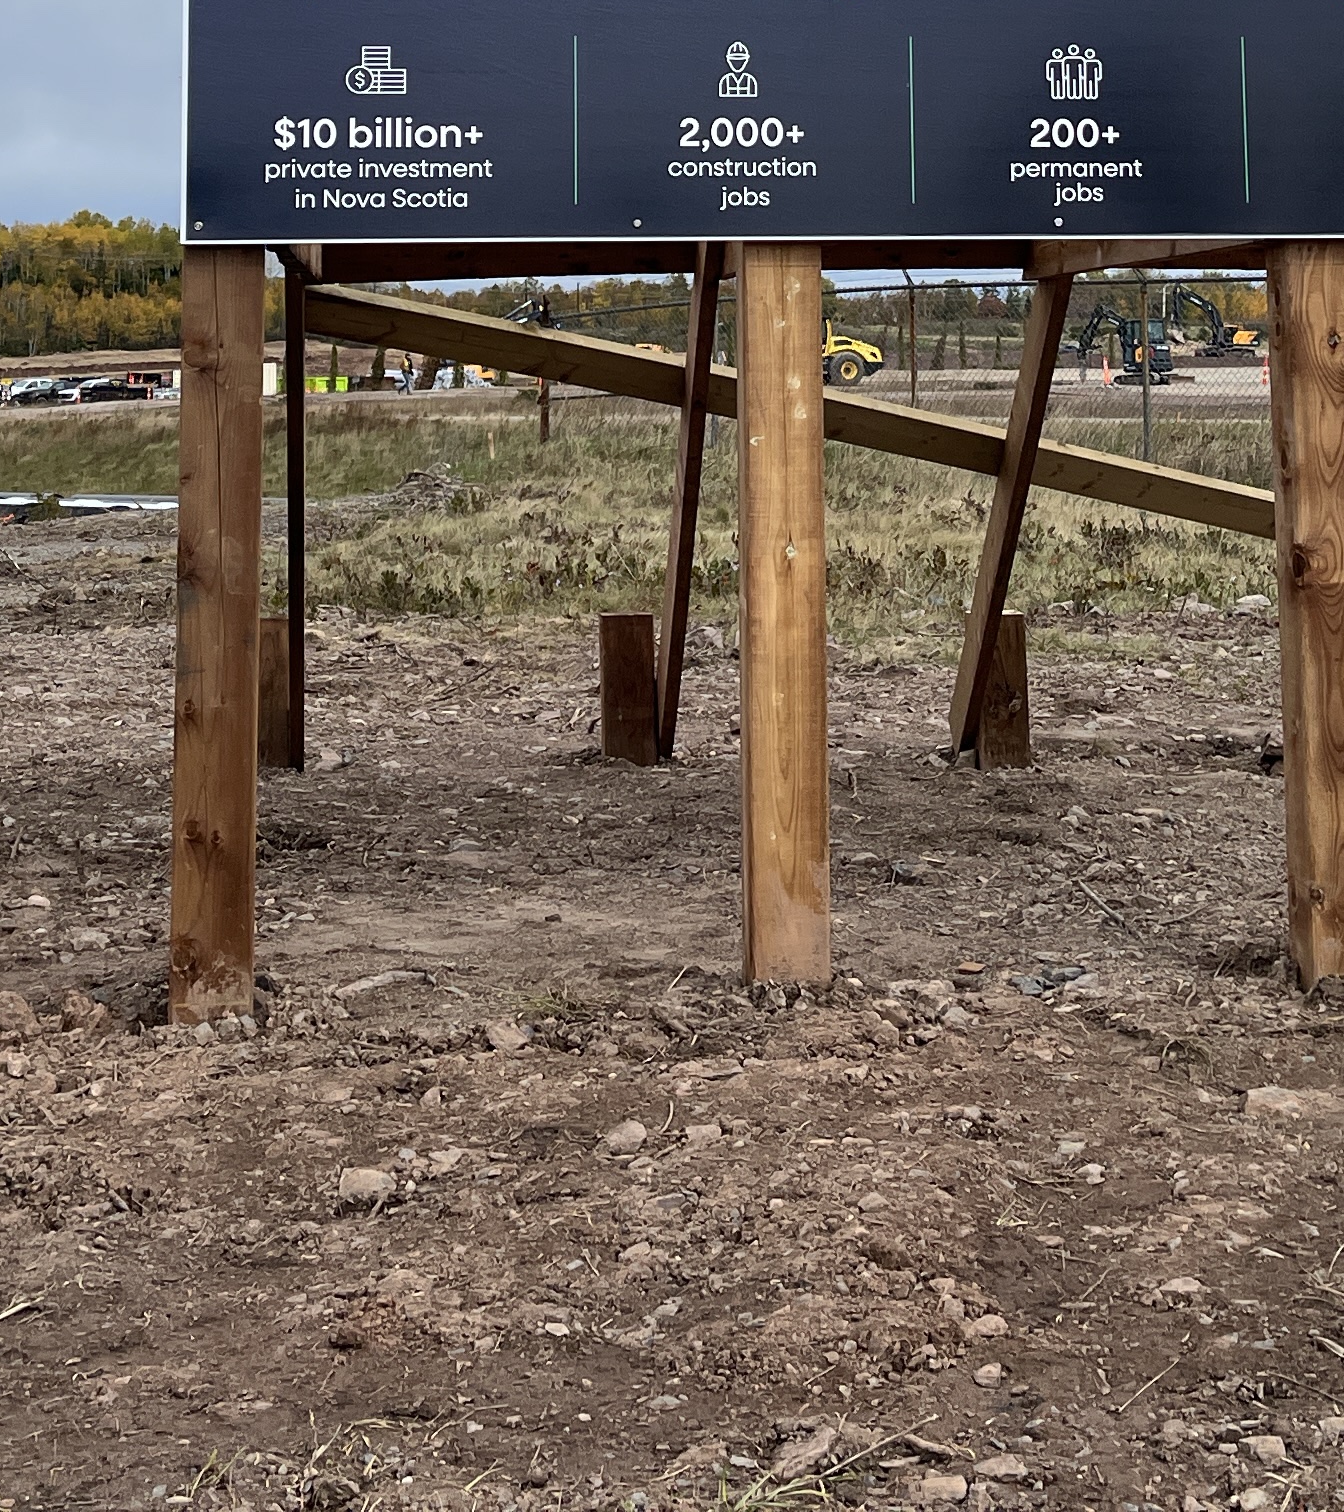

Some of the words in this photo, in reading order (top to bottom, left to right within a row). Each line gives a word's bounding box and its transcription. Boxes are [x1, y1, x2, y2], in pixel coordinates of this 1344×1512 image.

[273, 115, 337, 151] $10
[349, 116, 484, 149] billion+
[679, 117, 805, 153] 2,000+
[1030, 118, 1120, 148] 200+
[264, 158, 353, 183] private
[358, 157, 493, 178] investment
[667, 156, 817, 177] construction
[1010, 159, 1143, 182] permanent
[295, 188, 316, 209] in
[323, 188, 386, 209] Nova
[392, 187, 468, 208] Scotia
[719, 186, 771, 211] jobs
[1053, 181, 1104, 207] jobs
